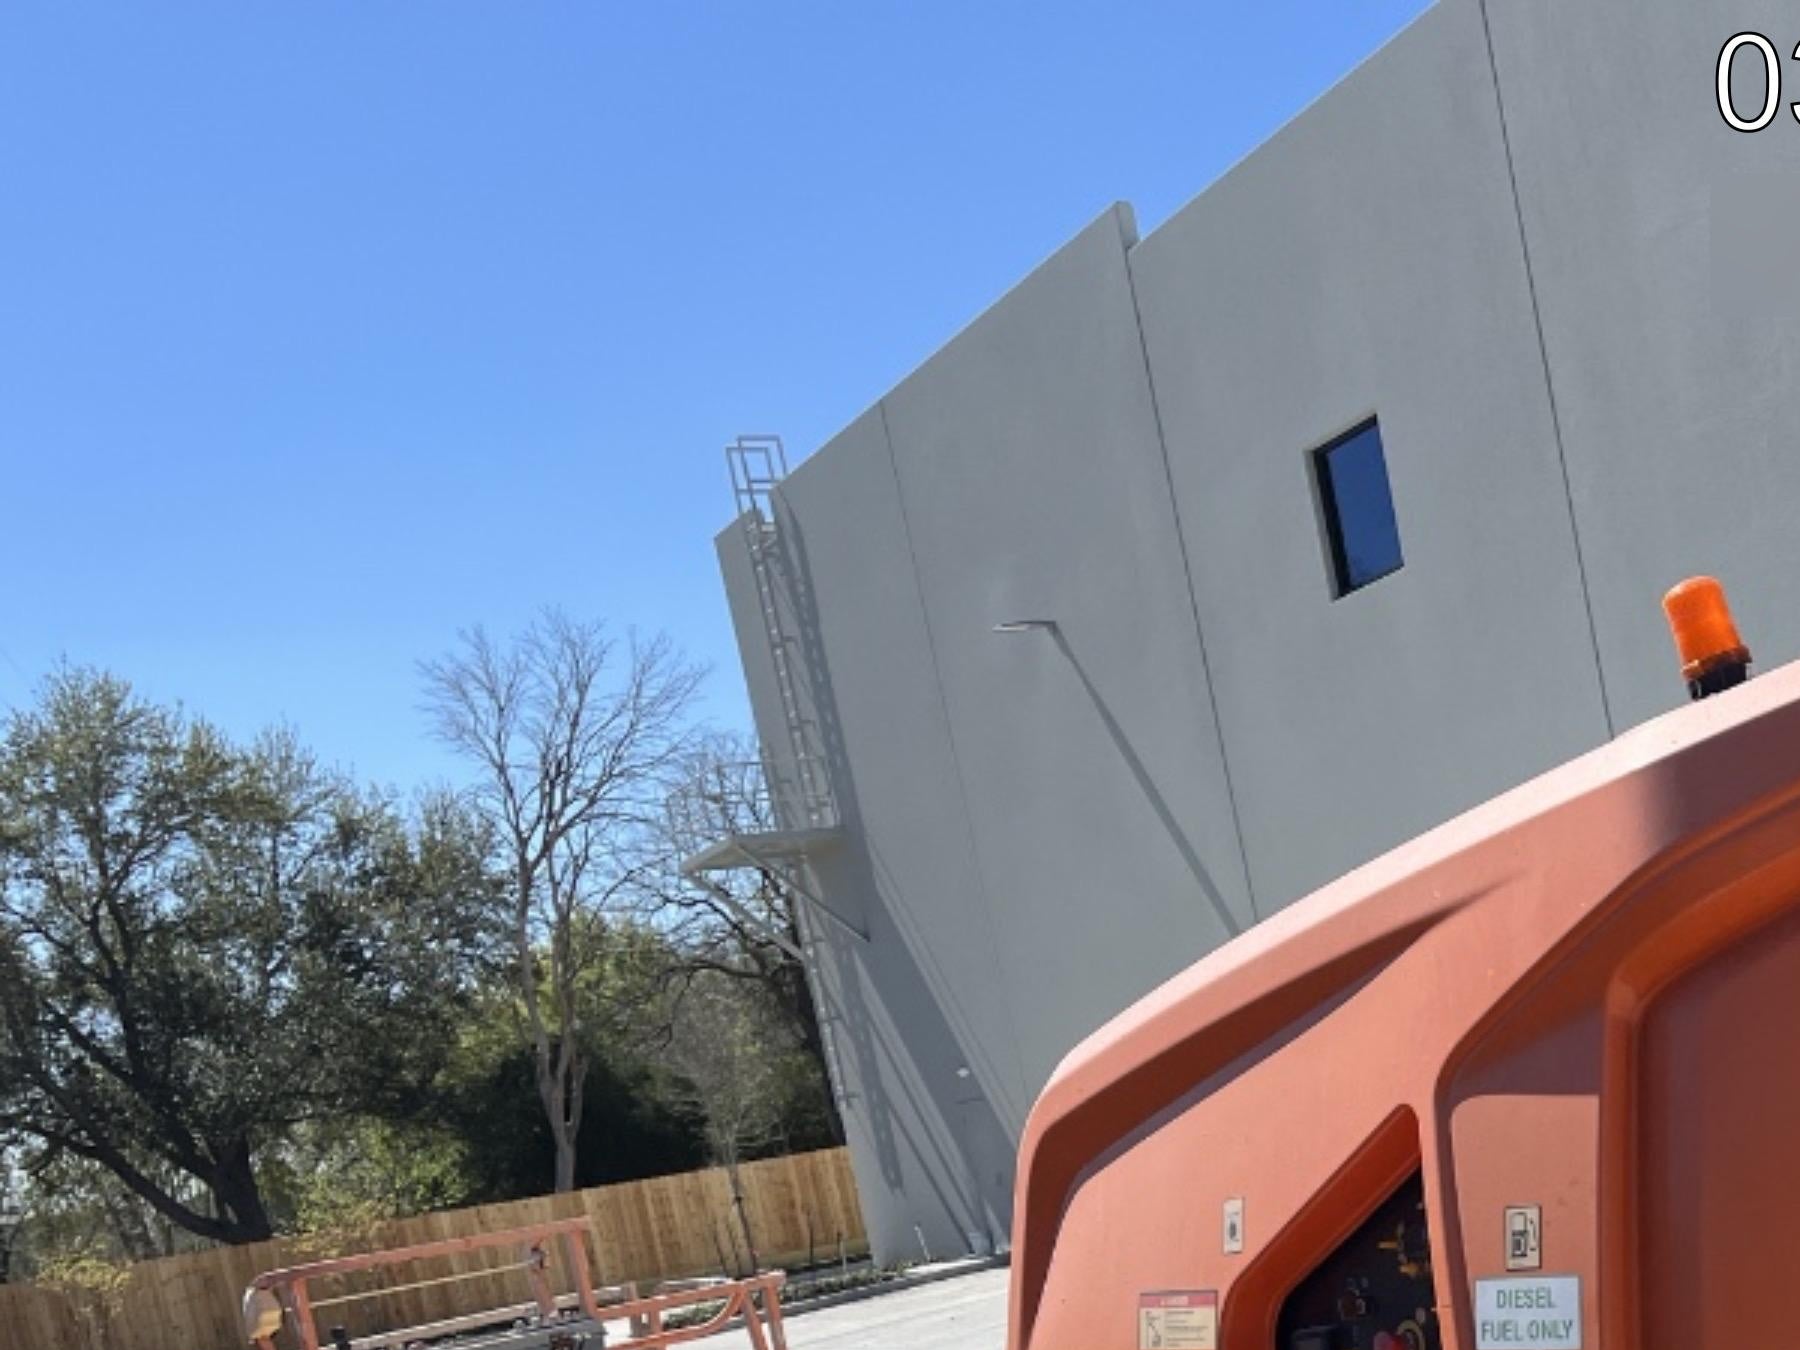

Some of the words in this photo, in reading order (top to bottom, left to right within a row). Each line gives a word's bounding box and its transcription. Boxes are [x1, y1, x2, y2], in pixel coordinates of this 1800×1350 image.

[1496, 1287, 1558, 1309] DIESEL
[1481, 1319, 1523, 1342] FUEL
[1527, 1318, 1574, 1341] ONLY
